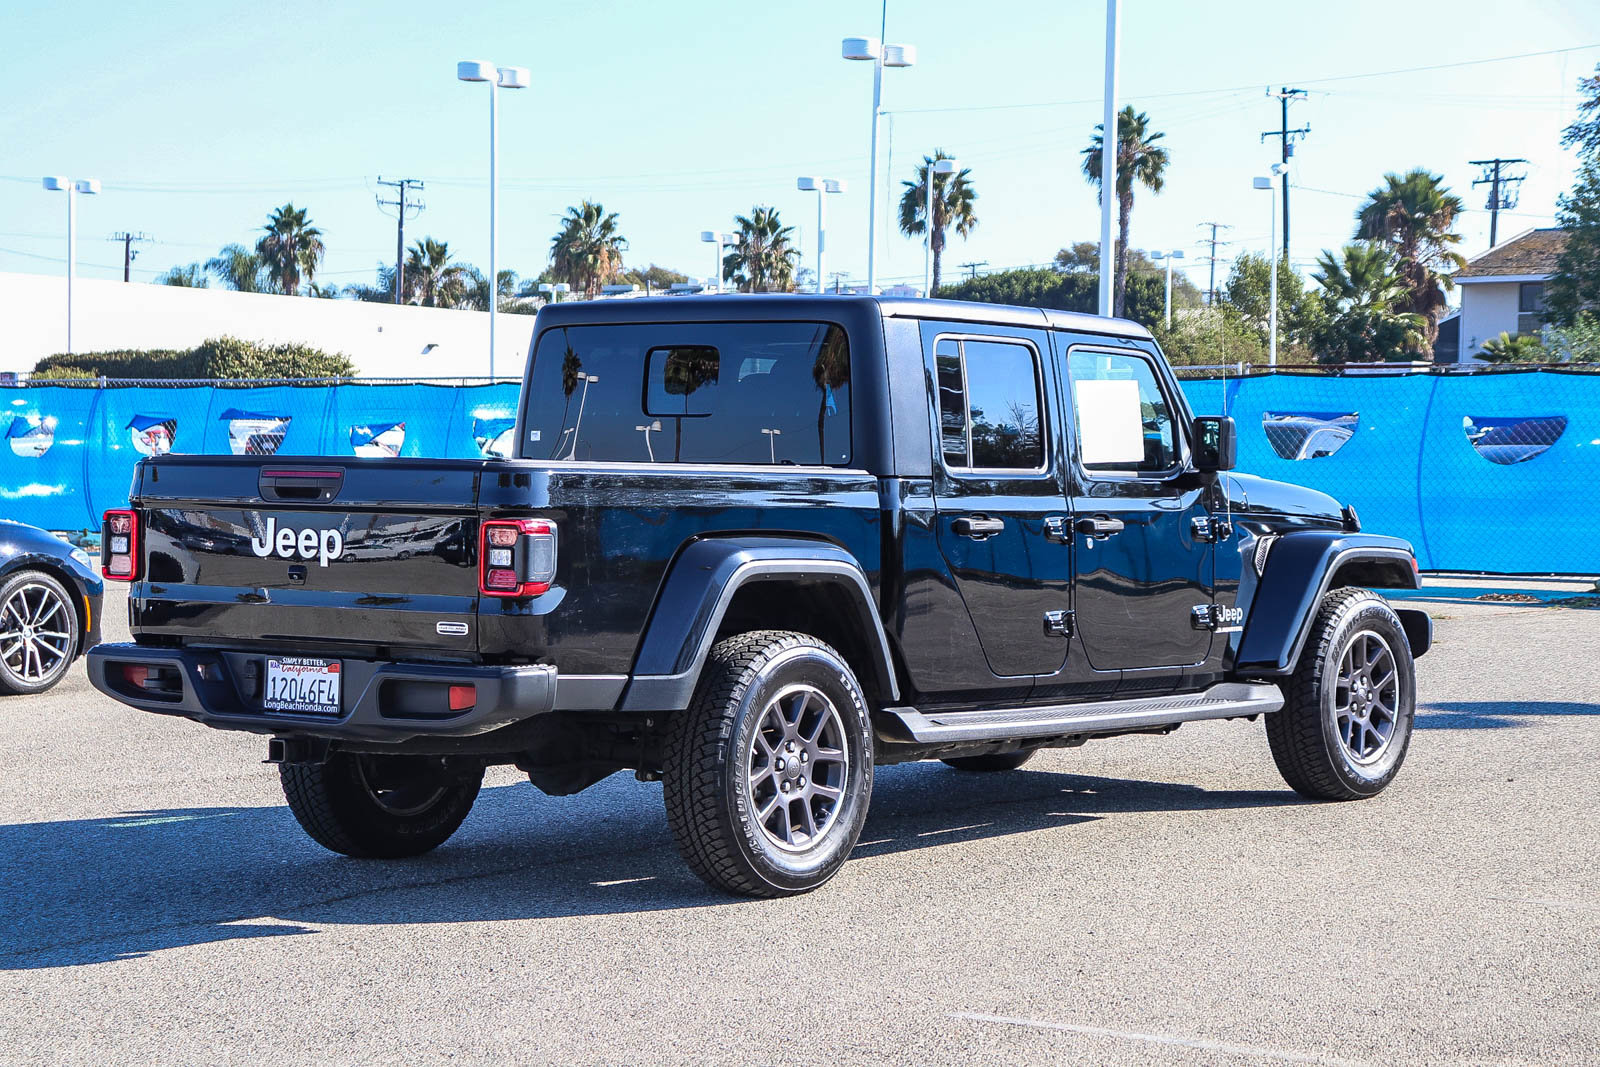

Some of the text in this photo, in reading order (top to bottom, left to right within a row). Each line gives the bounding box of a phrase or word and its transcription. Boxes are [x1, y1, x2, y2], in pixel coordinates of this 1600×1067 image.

[252, 517, 343, 567] Jeep
[1219, 605, 1243, 624] Jeep
[282, 657, 302, 665] SIMPLY
[270, 676, 336, 704] 12046F4
[264, 700, 338, 713] LongBeachHonda.com
